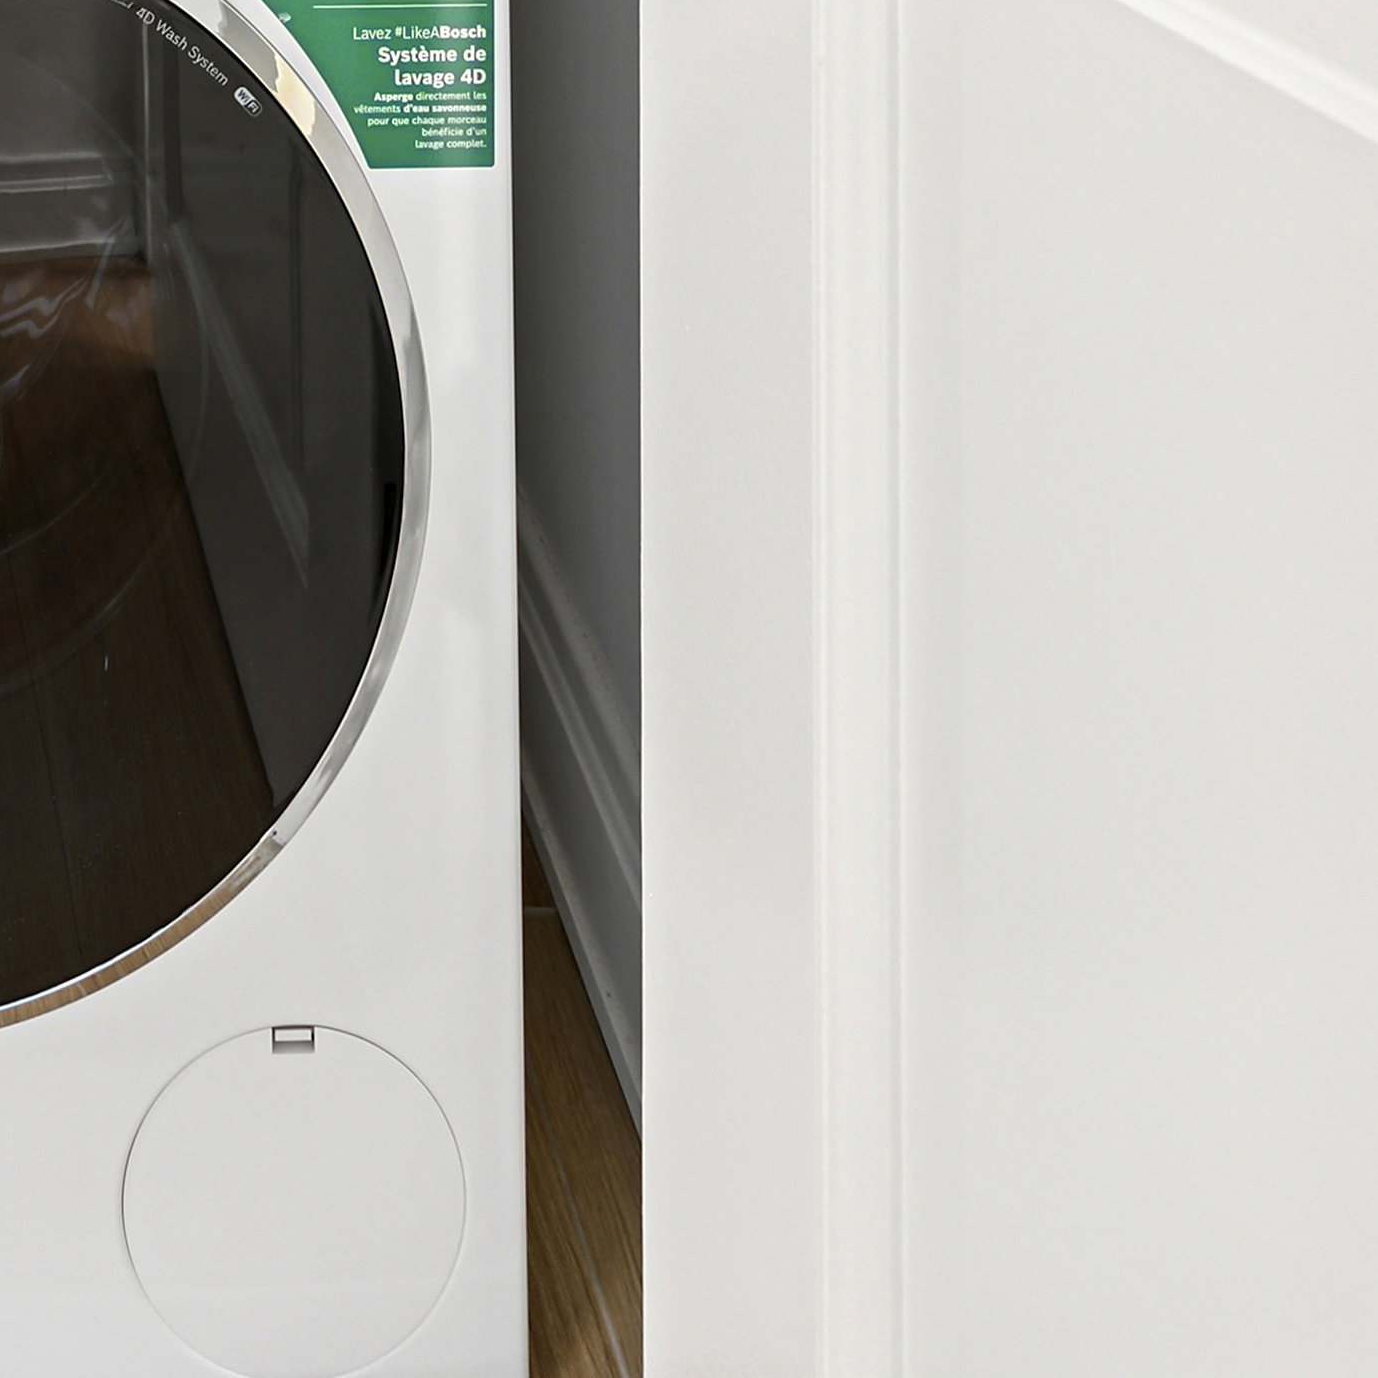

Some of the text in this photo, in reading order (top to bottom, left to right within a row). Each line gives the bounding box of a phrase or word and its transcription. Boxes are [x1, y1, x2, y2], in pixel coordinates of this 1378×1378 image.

[353, 25, 486, 40] Lavez #LikeABosch
[136, 8, 229, 86] 4D Wash System
[378, 45, 486, 65] Système de
[395, 68, 486, 88] lavage 4D
[374, 91, 487, 103] Asperge directement les
[354, 104, 487, 113] vêtements d'eau savonneuse
[368, 116, 487, 127] pour que chaque morceau
[415, 140, 487, 150] lavage complet.
